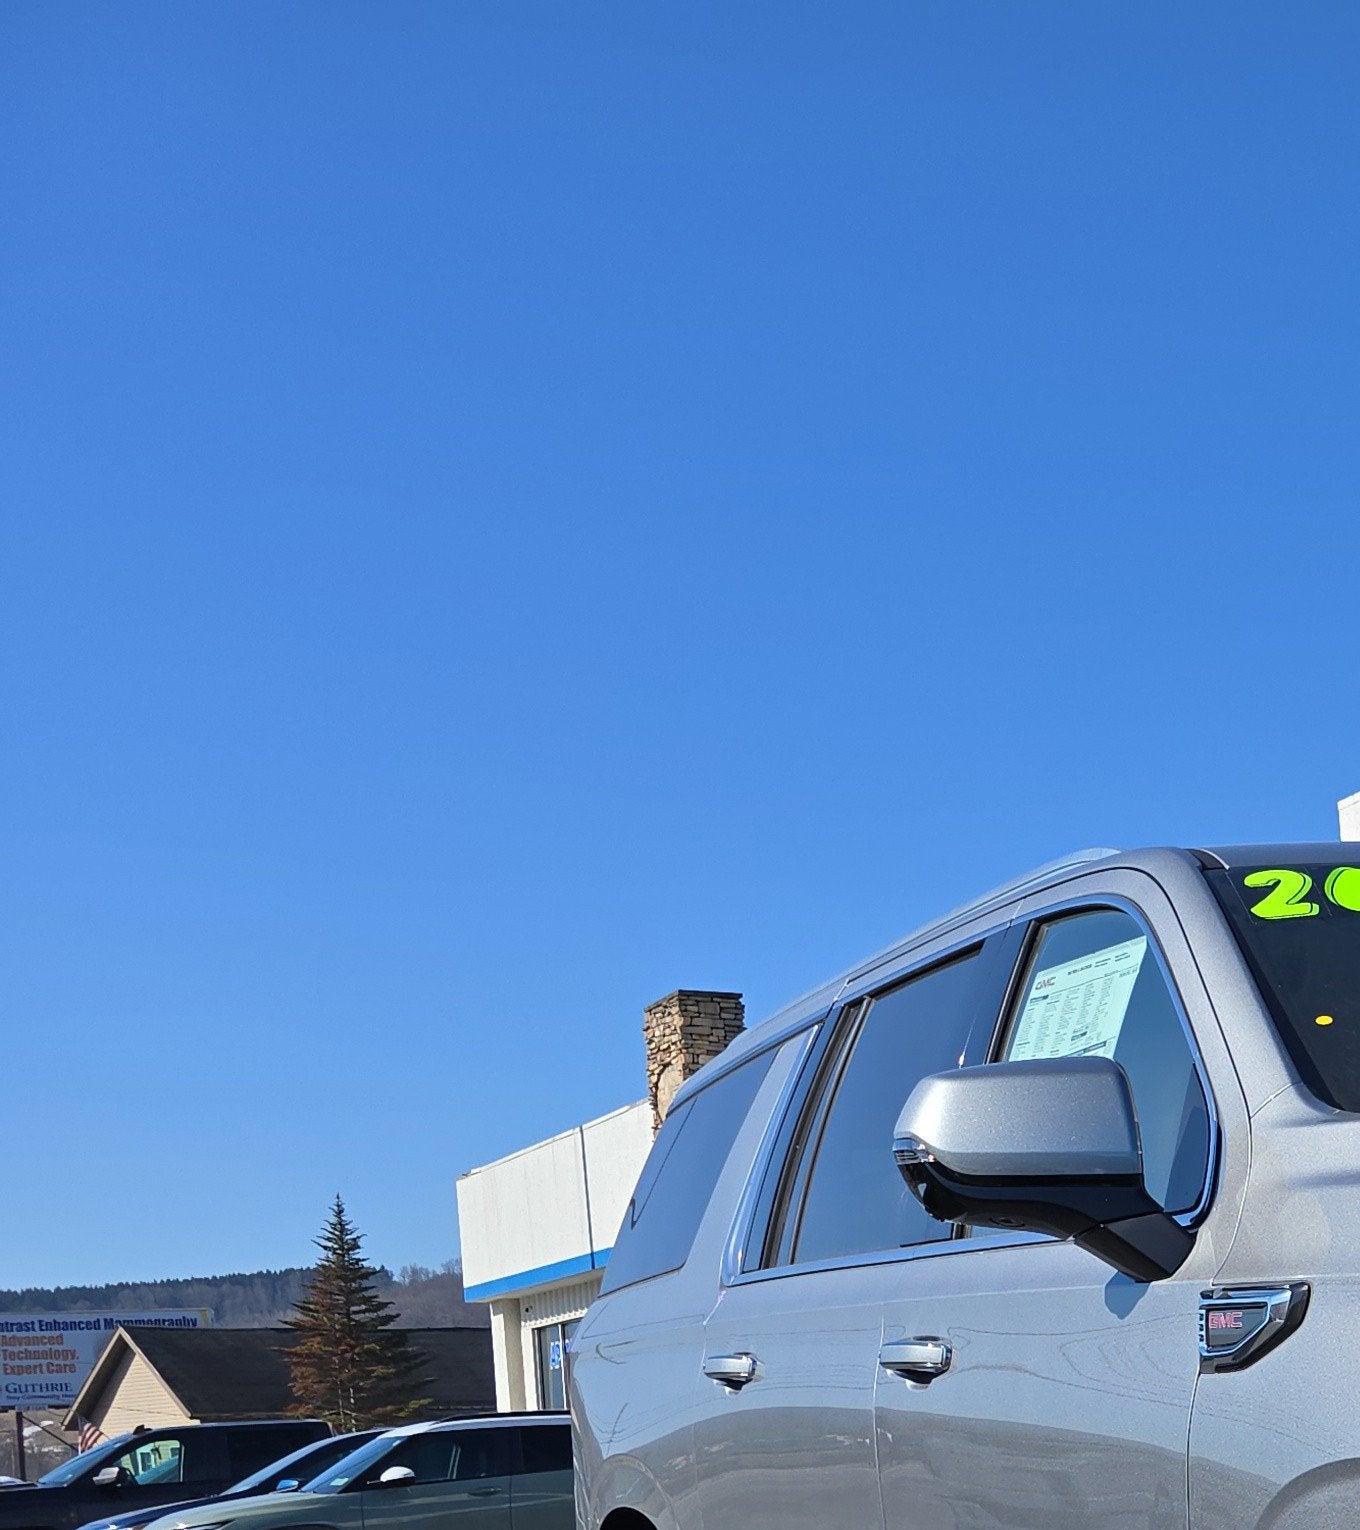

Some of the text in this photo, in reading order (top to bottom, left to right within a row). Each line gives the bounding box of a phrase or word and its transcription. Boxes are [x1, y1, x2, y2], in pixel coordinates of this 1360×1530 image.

[38, 1318, 101, 1332] Enhanced
[1209, 1312, 1243, 1329] GMC
[1, 1333, 64, 1347] Advanced
[3, 1361, 77, 1375] Expert Care
